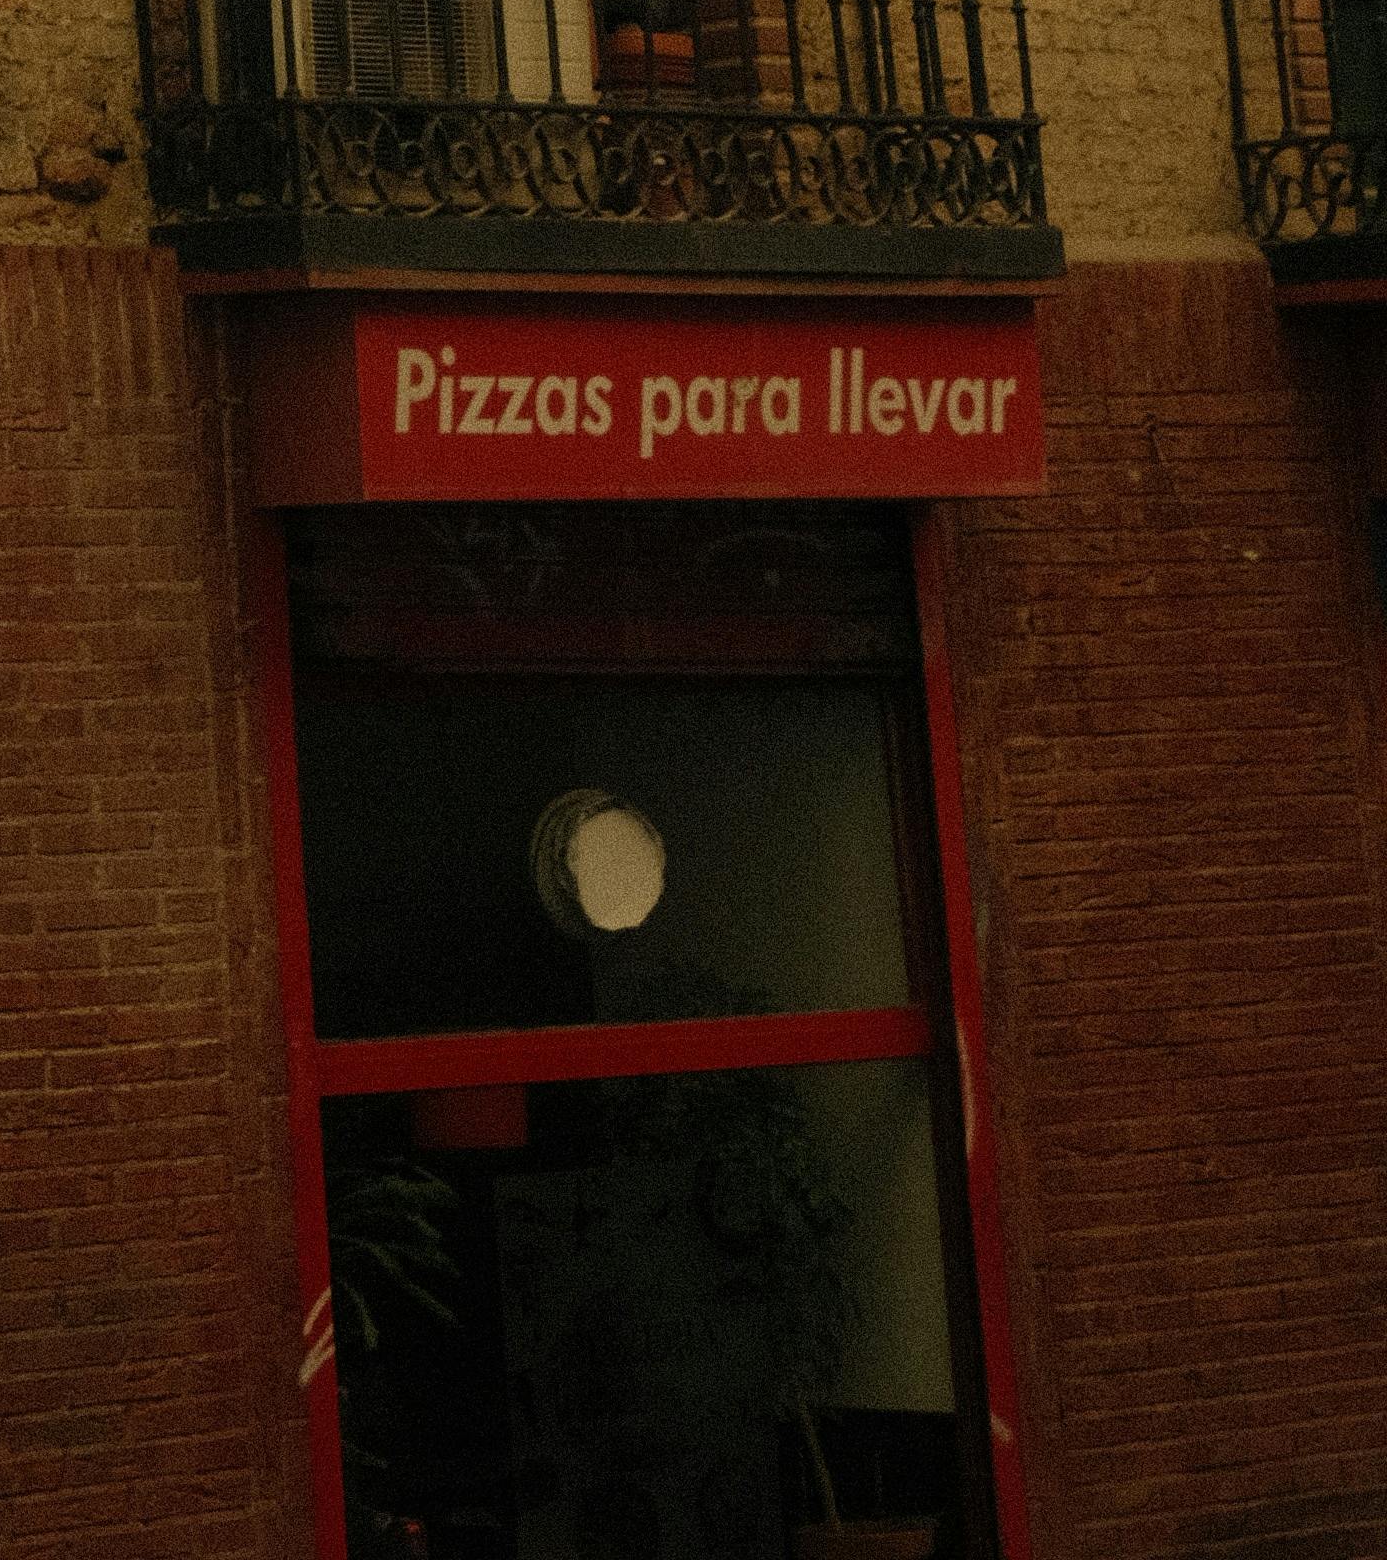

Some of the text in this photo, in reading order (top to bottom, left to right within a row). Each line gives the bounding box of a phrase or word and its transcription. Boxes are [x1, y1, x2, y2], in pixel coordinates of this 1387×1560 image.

[395, 346, 1018, 459] Pizzas para llevar
